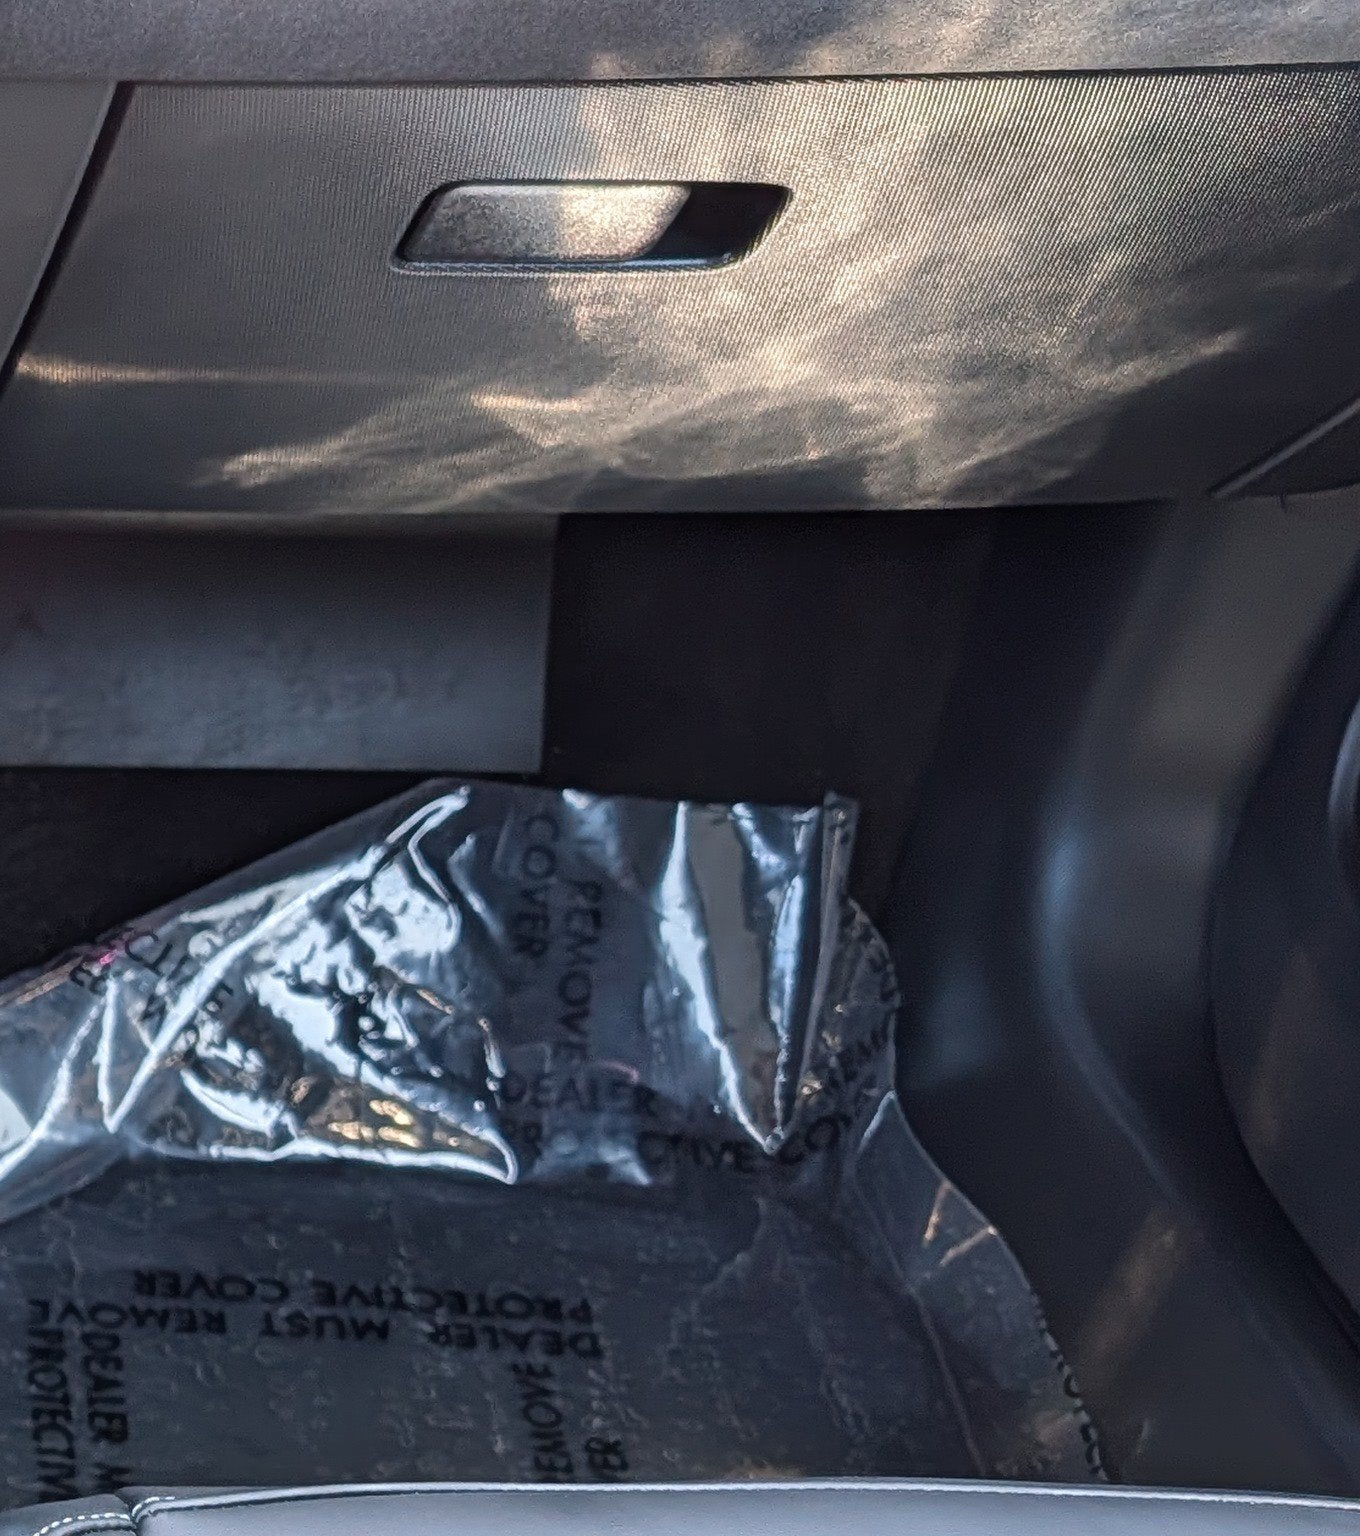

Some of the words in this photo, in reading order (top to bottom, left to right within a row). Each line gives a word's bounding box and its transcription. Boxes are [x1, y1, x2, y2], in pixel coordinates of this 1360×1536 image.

[132, 1268, 291, 1302] COVER
[260, 1309, 392, 1342] MUST
[428, 1321, 606, 1361] DEALER
